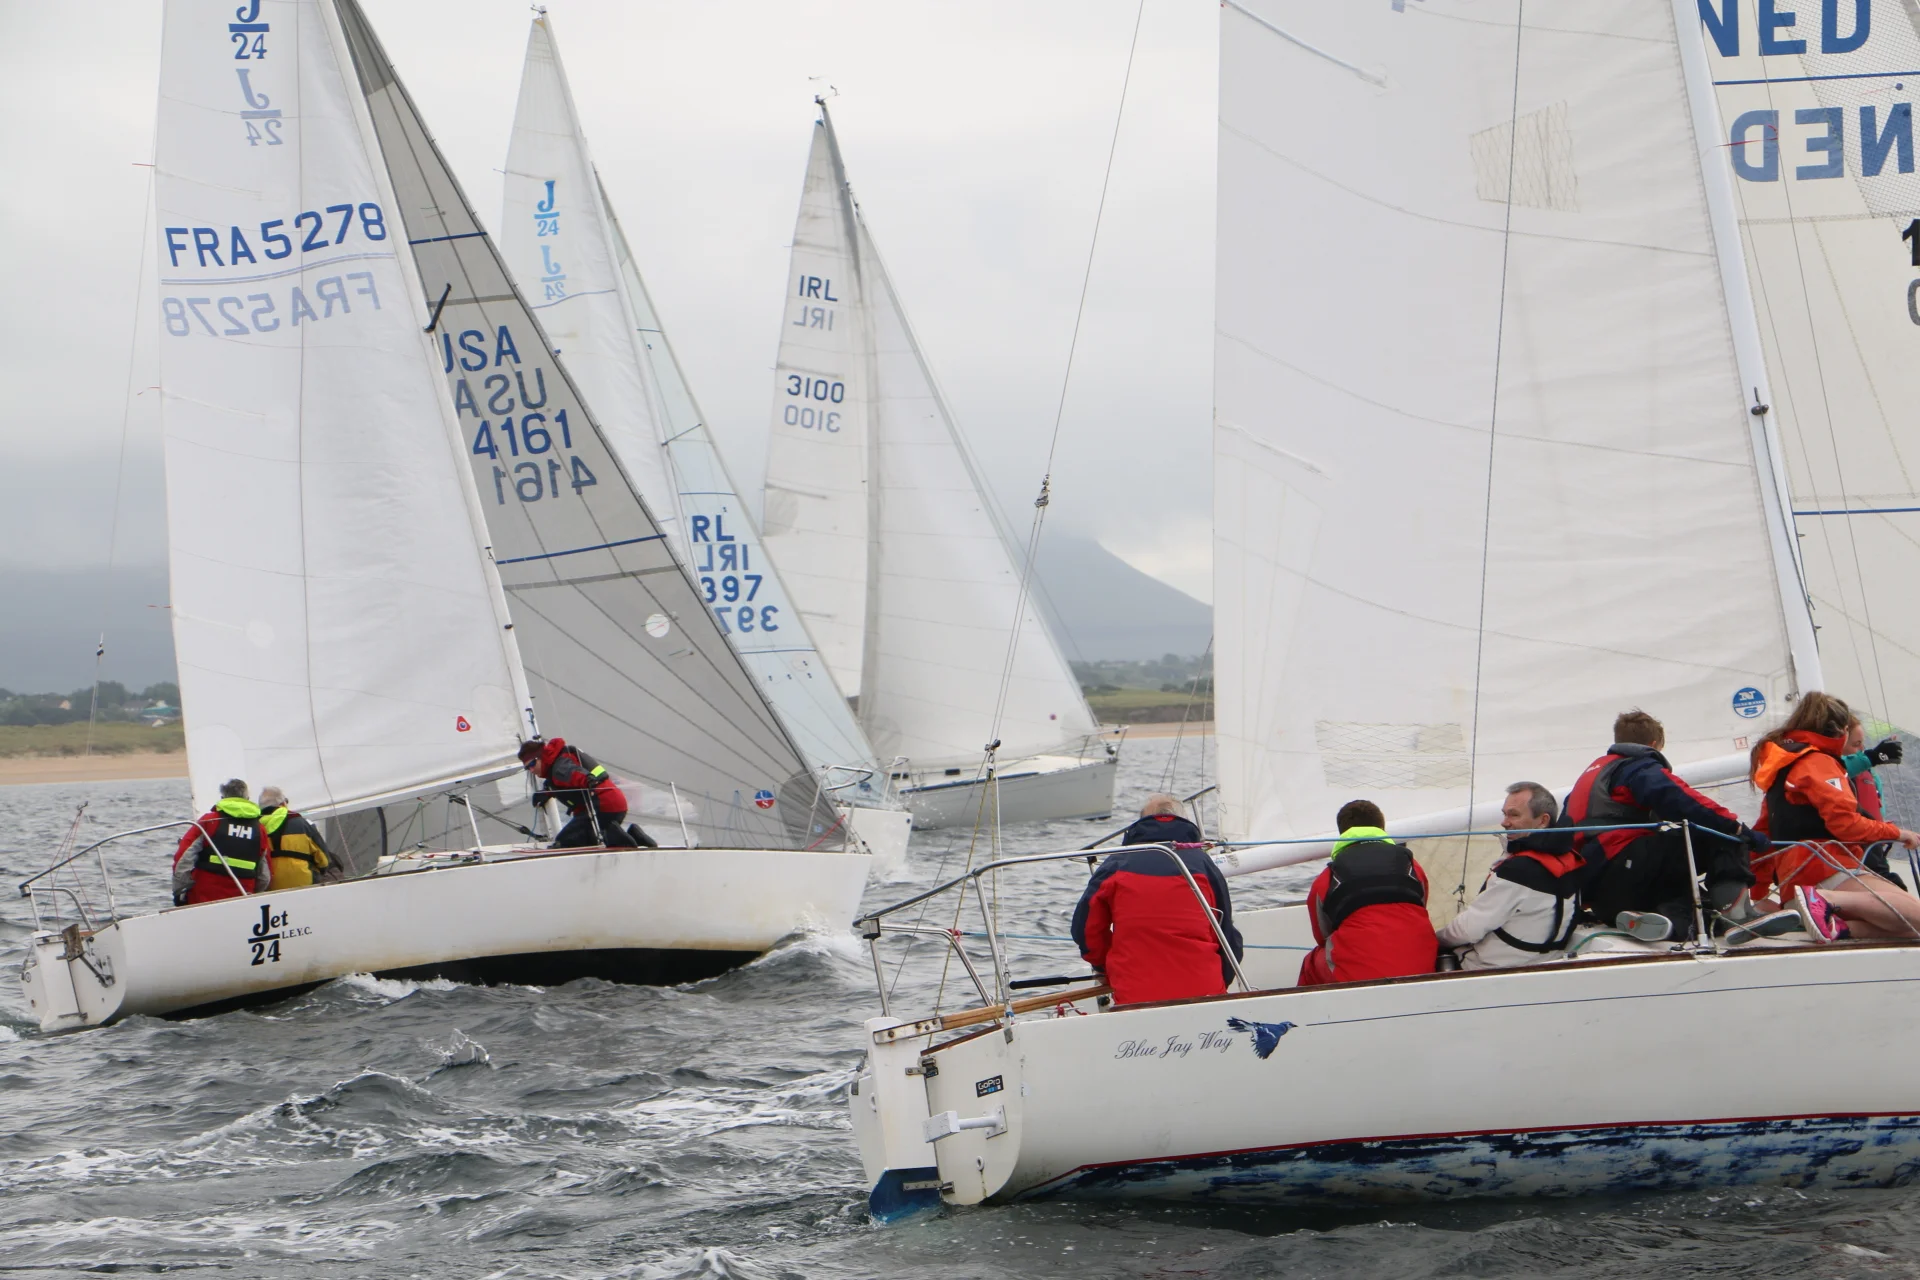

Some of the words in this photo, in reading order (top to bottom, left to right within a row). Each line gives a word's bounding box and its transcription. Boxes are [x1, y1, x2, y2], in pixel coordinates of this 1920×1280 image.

[1697, 0, 1871, 57] NED
[231, 32, 268, 60] 24
[537, 180, 556, 212] J
[537, 219, 560, 237] 24
[799, 275, 839, 302] IRL
[786, 375, 845, 403] 3100
[472, 408, 572, 460] 4161
[692, 515, 735, 542] RL
[701, 575, 763, 603] 397
[228, 823, 253, 840] HH
[252, 904, 289, 937] Jet
[251, 940, 282, 966] 24
[1114, 1039, 1158, 1060] Blue
[1159, 1035, 1193, 1059] Jay
[1198, 1030, 1234, 1054] Way
[977, 1078, 1001, 1091] GoPro
